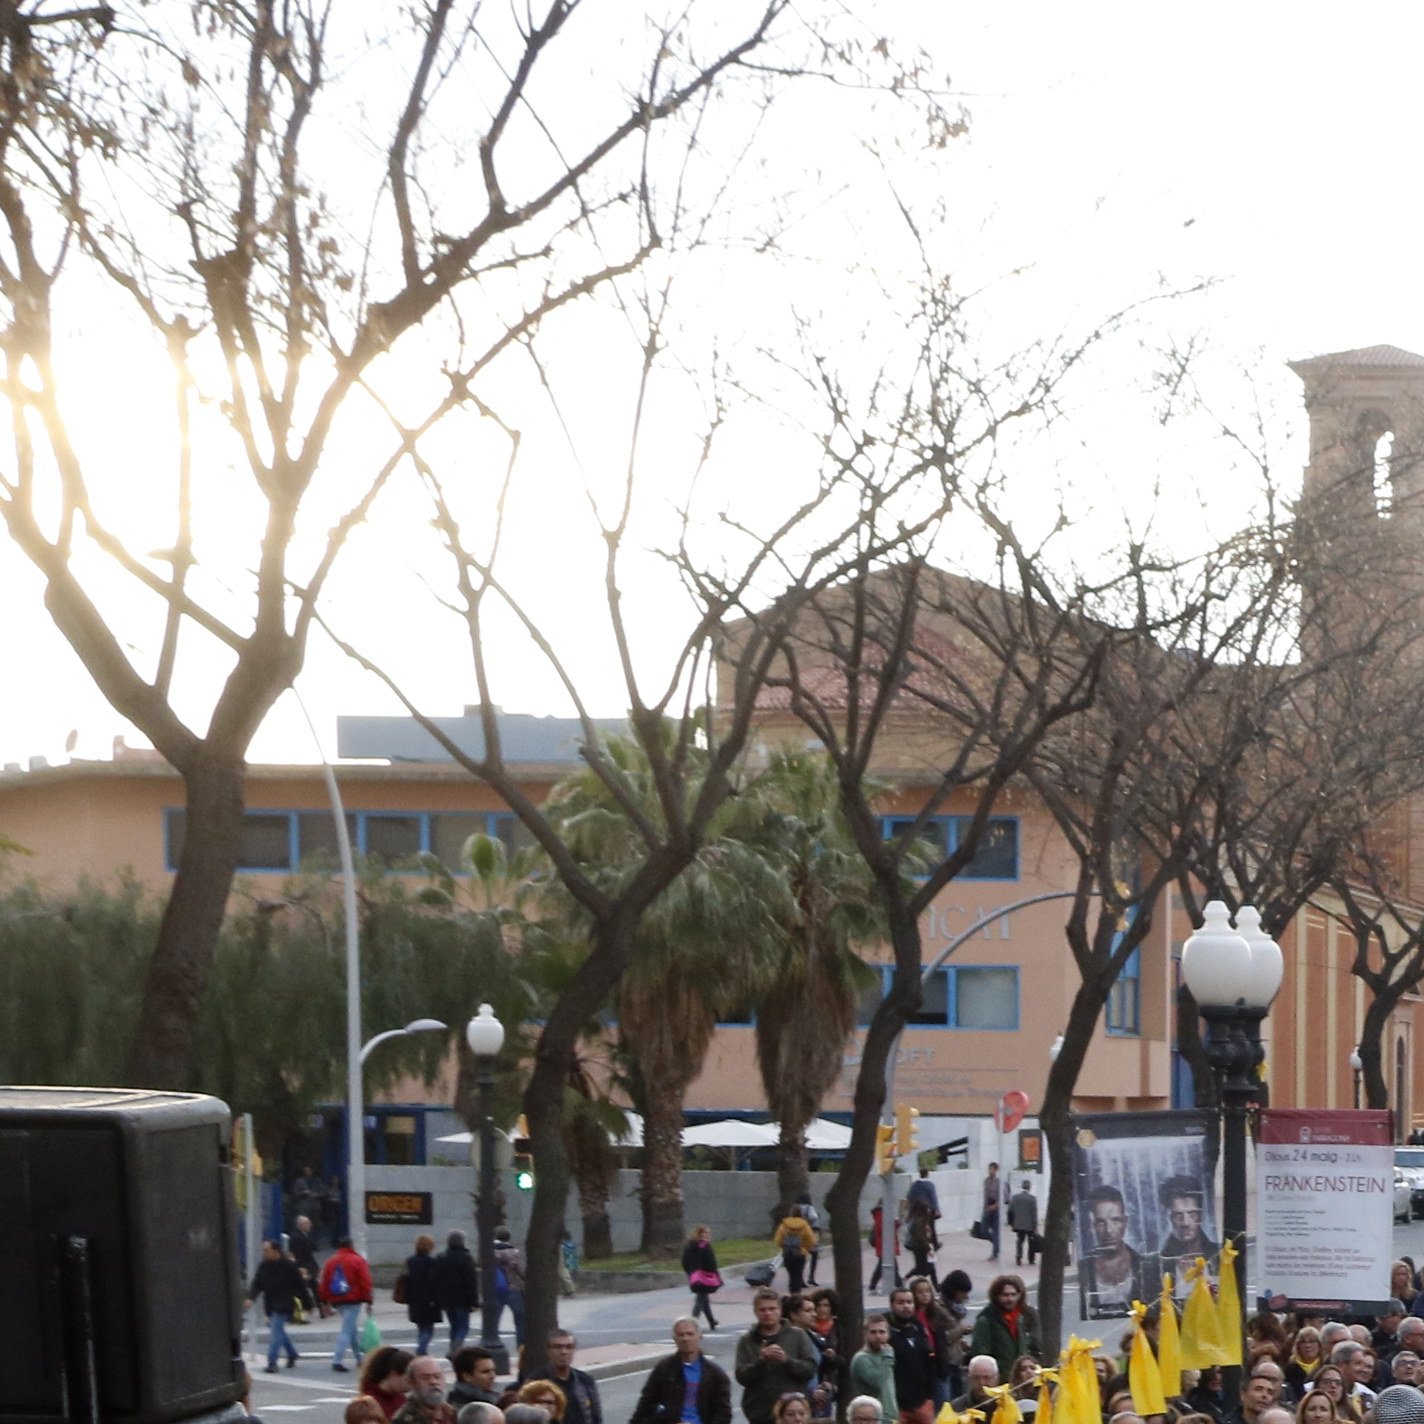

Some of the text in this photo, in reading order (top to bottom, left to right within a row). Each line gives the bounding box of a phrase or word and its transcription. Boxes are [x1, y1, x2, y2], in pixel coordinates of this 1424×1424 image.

[1293, 1149, 1307, 1161] 24
[1311, 1151, 1338, 1163] maig
[1265, 1175, 1386, 1193] FRANKENSTEIN
